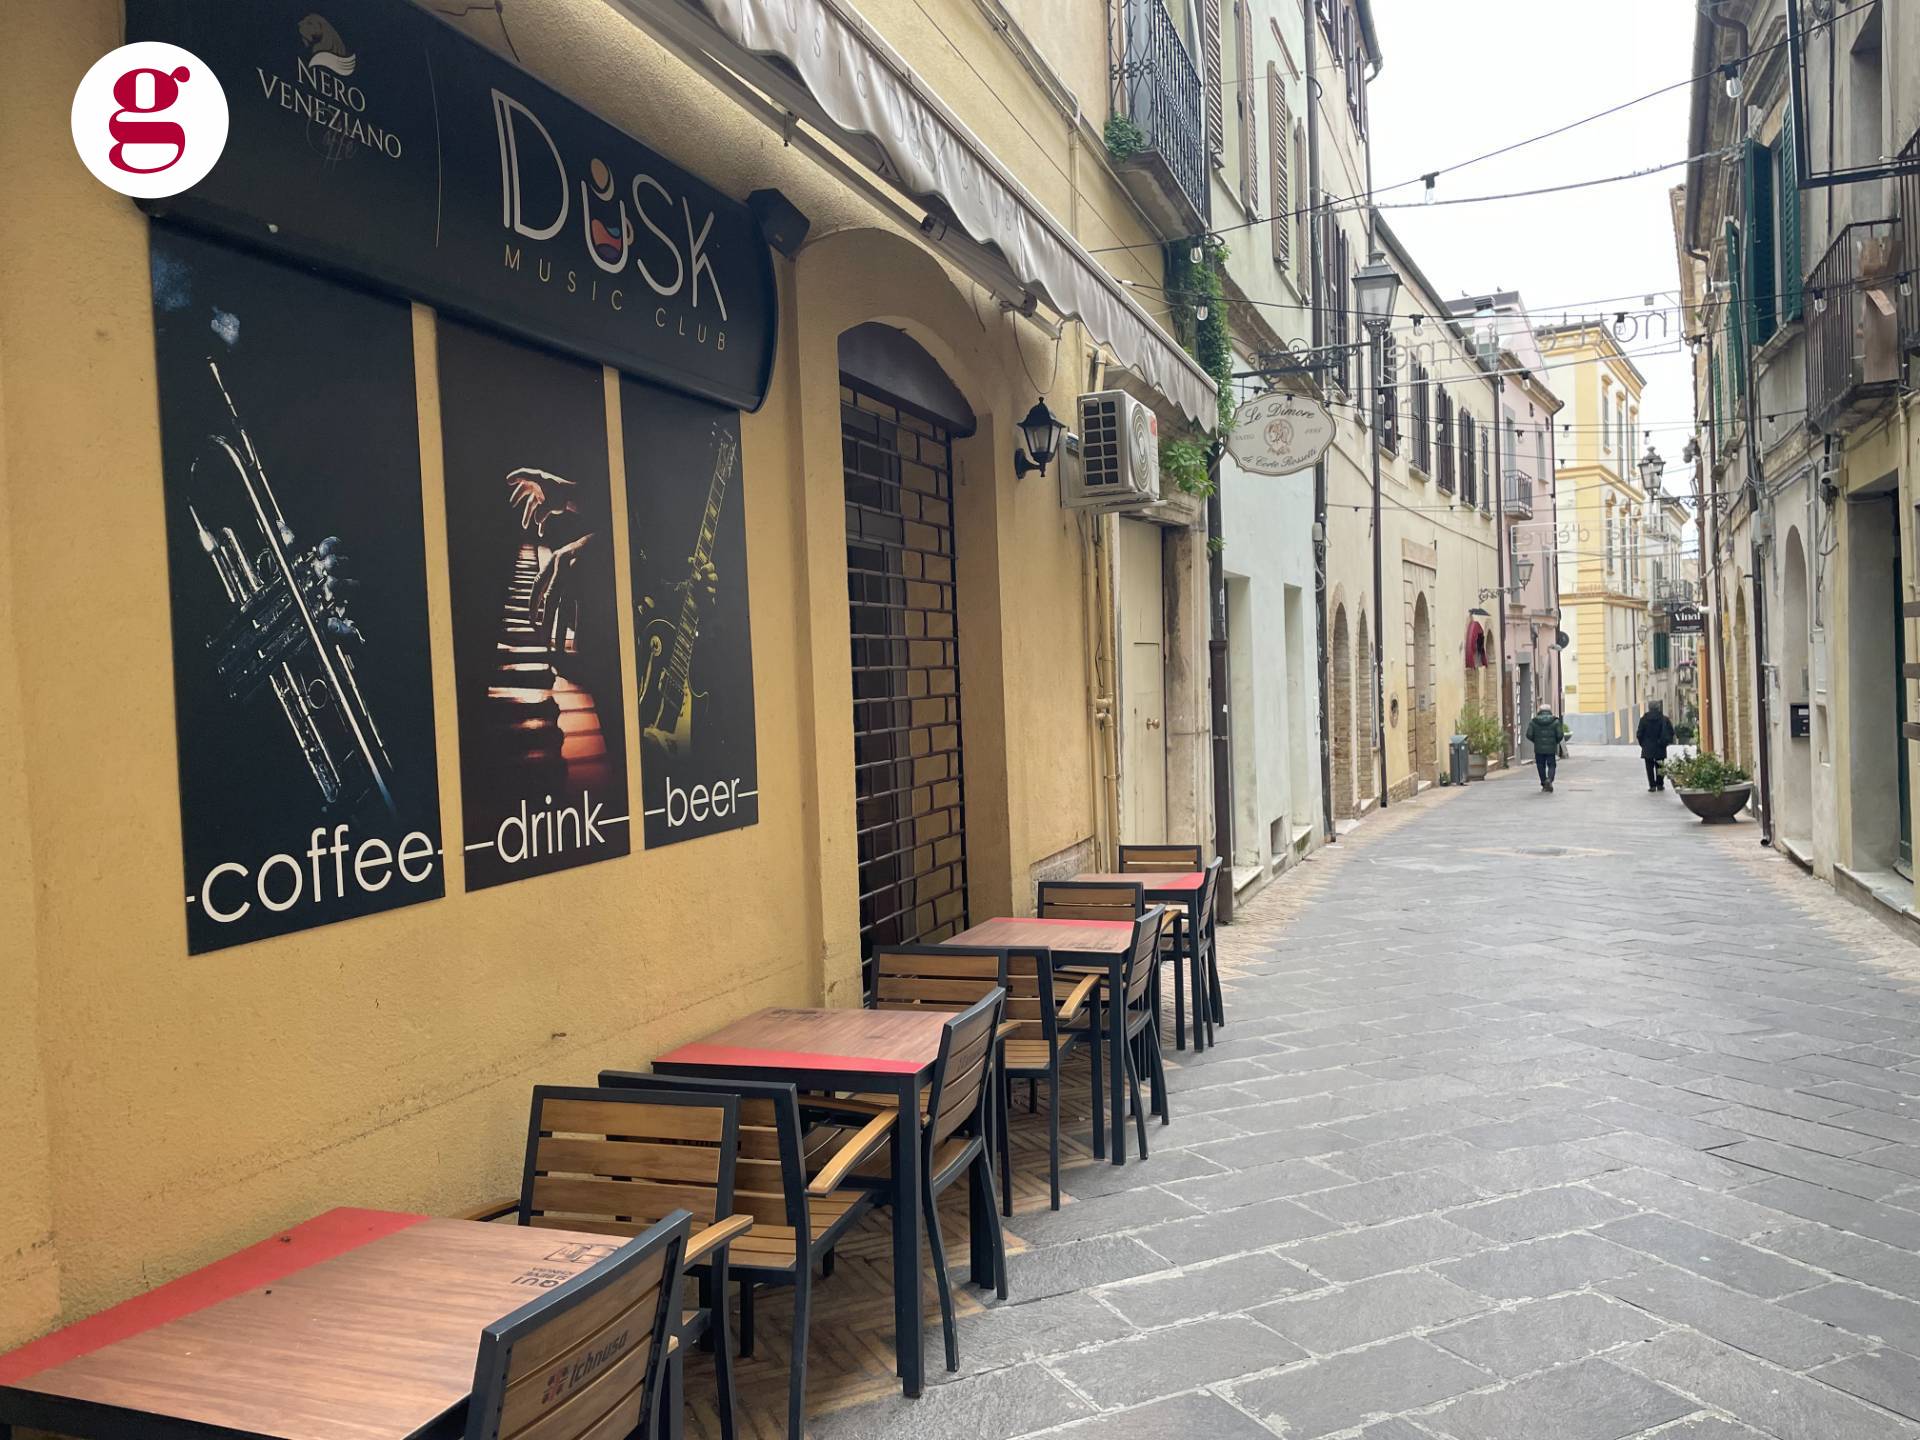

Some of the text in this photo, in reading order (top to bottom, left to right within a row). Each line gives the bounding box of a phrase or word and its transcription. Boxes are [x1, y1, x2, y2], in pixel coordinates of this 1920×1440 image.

[255, 66, 402, 158] VENEZIANO
[297, 56, 366, 112] NERO
[504, 244, 726, 351] MUSIC CLUB
[1243, 402, 1316, 426] Le Dimore
[497, 790, 607, 864] drink
[665, 777, 740, 828] beer
[200, 824, 434, 924] coffee
[511, 1276, 559, 1288] QUI
[568, 1329, 629, 1389] Ichnusa
